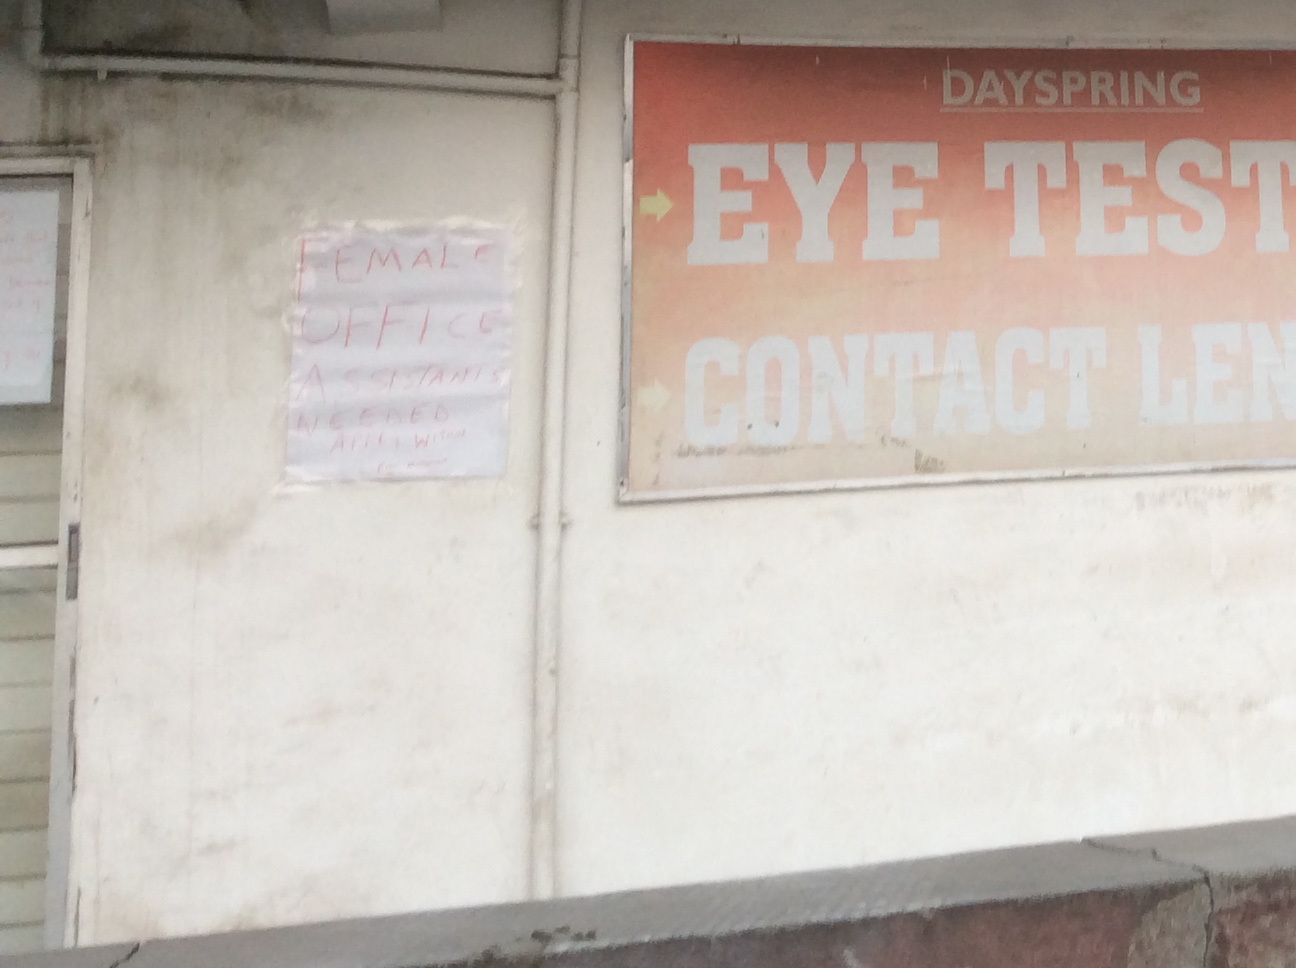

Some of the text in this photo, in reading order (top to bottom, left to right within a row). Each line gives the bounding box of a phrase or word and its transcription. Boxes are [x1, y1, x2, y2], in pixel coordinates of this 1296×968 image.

[942, 68, 1202, 107] DAYSPRING
[686, 141, 940, 266] EYE
[682, 325, 1107, 449] CONTACT
